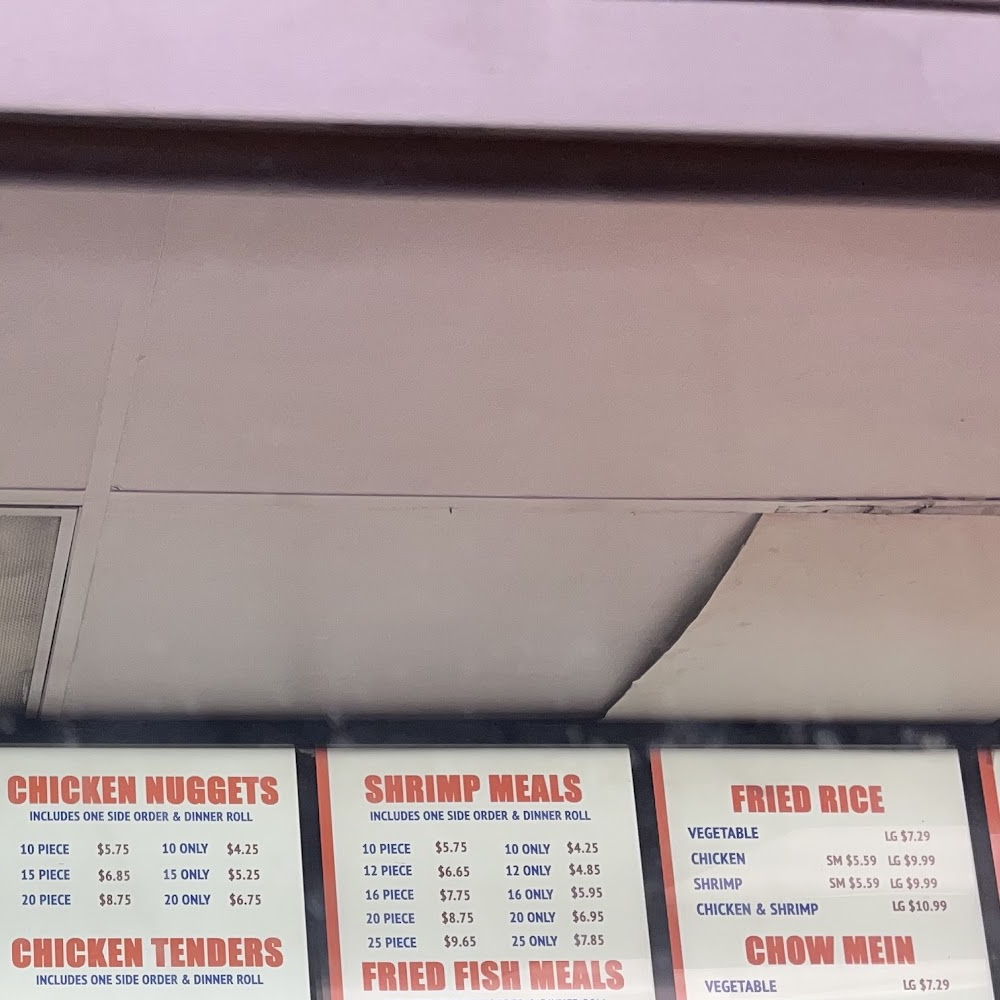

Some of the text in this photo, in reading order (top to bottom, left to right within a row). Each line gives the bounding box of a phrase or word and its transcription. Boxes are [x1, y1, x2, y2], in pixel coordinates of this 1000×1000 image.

[7, 775, 279, 805] CHICKEN NUGGETS
[364, 774, 582, 804] SHRIMP MEALS
[731, 785, 885, 814] FRIED RICE
[30, 811, 253, 822] INCLUDES ONE SIDE ORDER & DINNER ROLL
[687, 827, 759, 839] VEGETABLE
[885, 829, 930, 843] LG $7.29
[20, 844, 69, 855] 10 PIECE
[97, 842, 129, 856] $5.75
[162, 843, 208, 854] 10 ONLY
[227, 842, 259, 856] $4.25
[691, 852, 745, 865] CHICKEN
[826, 854, 877, 867] SM $5.59
[888, 854, 935, 867] LG $9.99
[368, 937, 417, 948] 25 PIECE
[444, 935, 476, 948] $9.65
[512, 935, 558, 947] 25 ONLY
[574, 933, 604, 947] $7.85
[12, 937, 283, 968] CHICKEN TENDERS
[745, 935, 915, 966] CHOW MEIN
[362, 960, 624, 991] FRIED FISH MEALS
